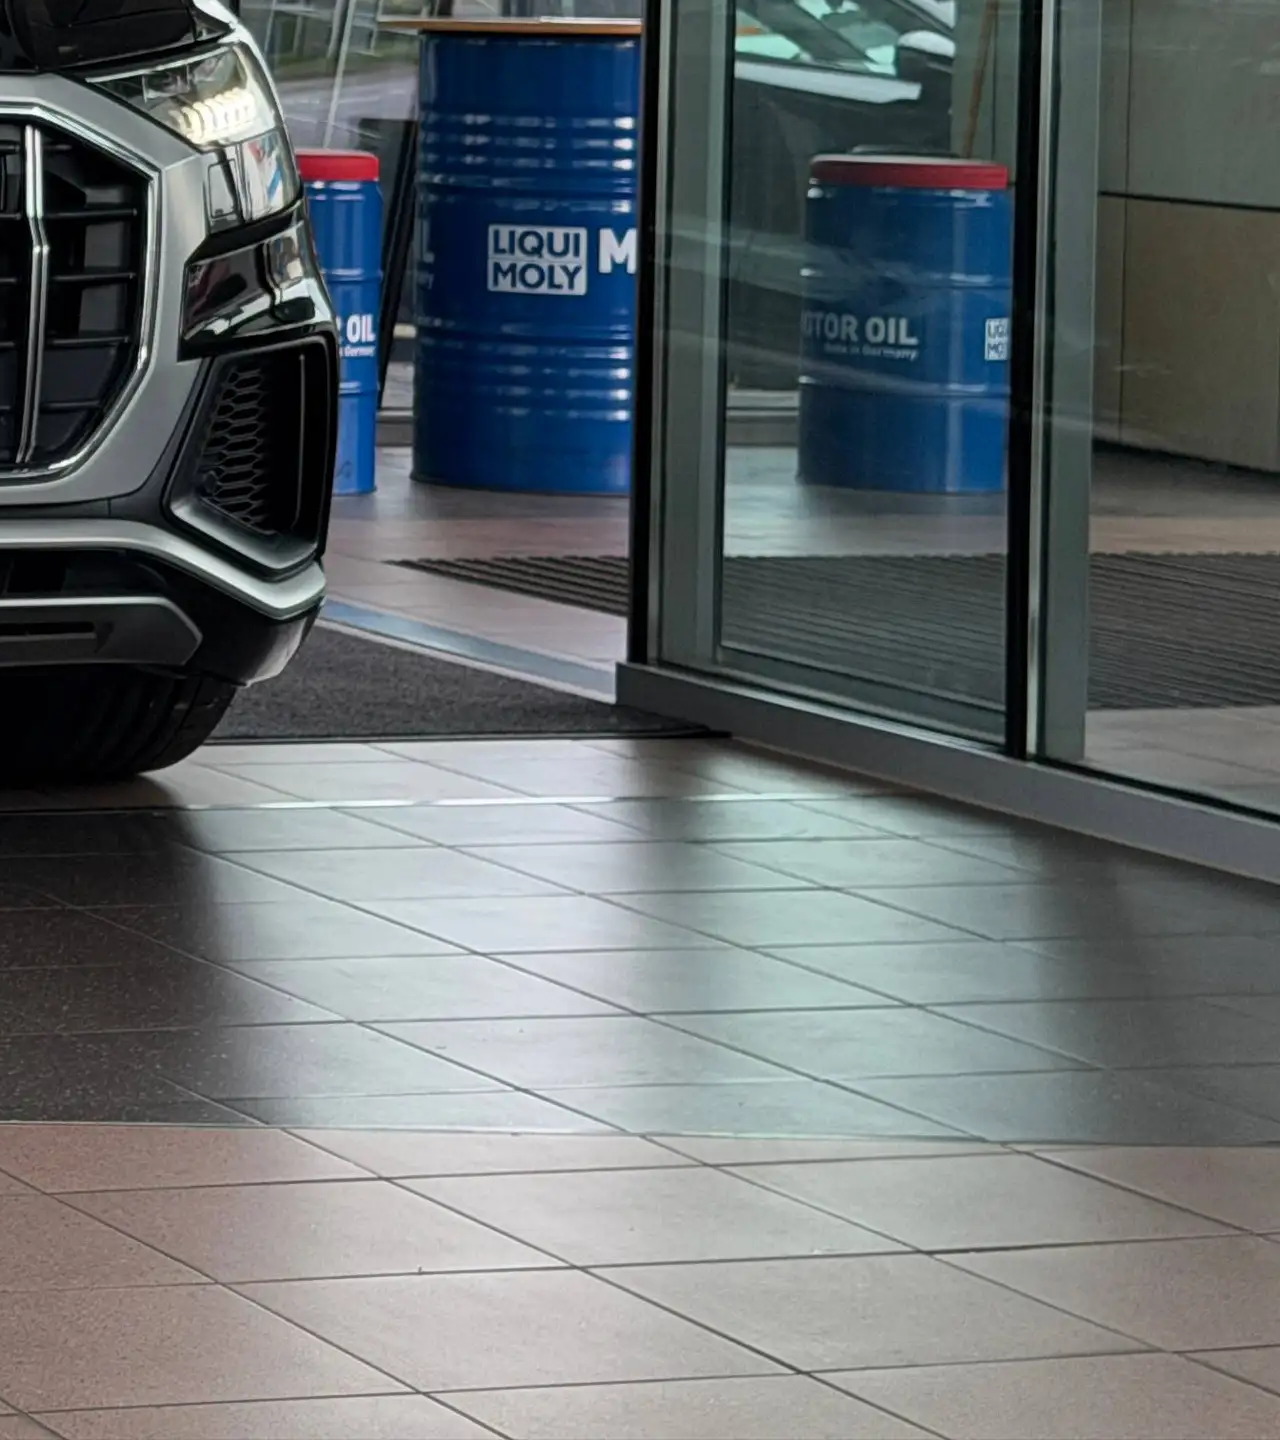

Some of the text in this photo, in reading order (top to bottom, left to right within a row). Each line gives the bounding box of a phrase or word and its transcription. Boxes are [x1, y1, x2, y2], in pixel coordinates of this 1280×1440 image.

[492, 228, 581, 258] LIQUI
[492, 262, 582, 291] MOLY
[801, 310, 919, 346] OTOR OIL
